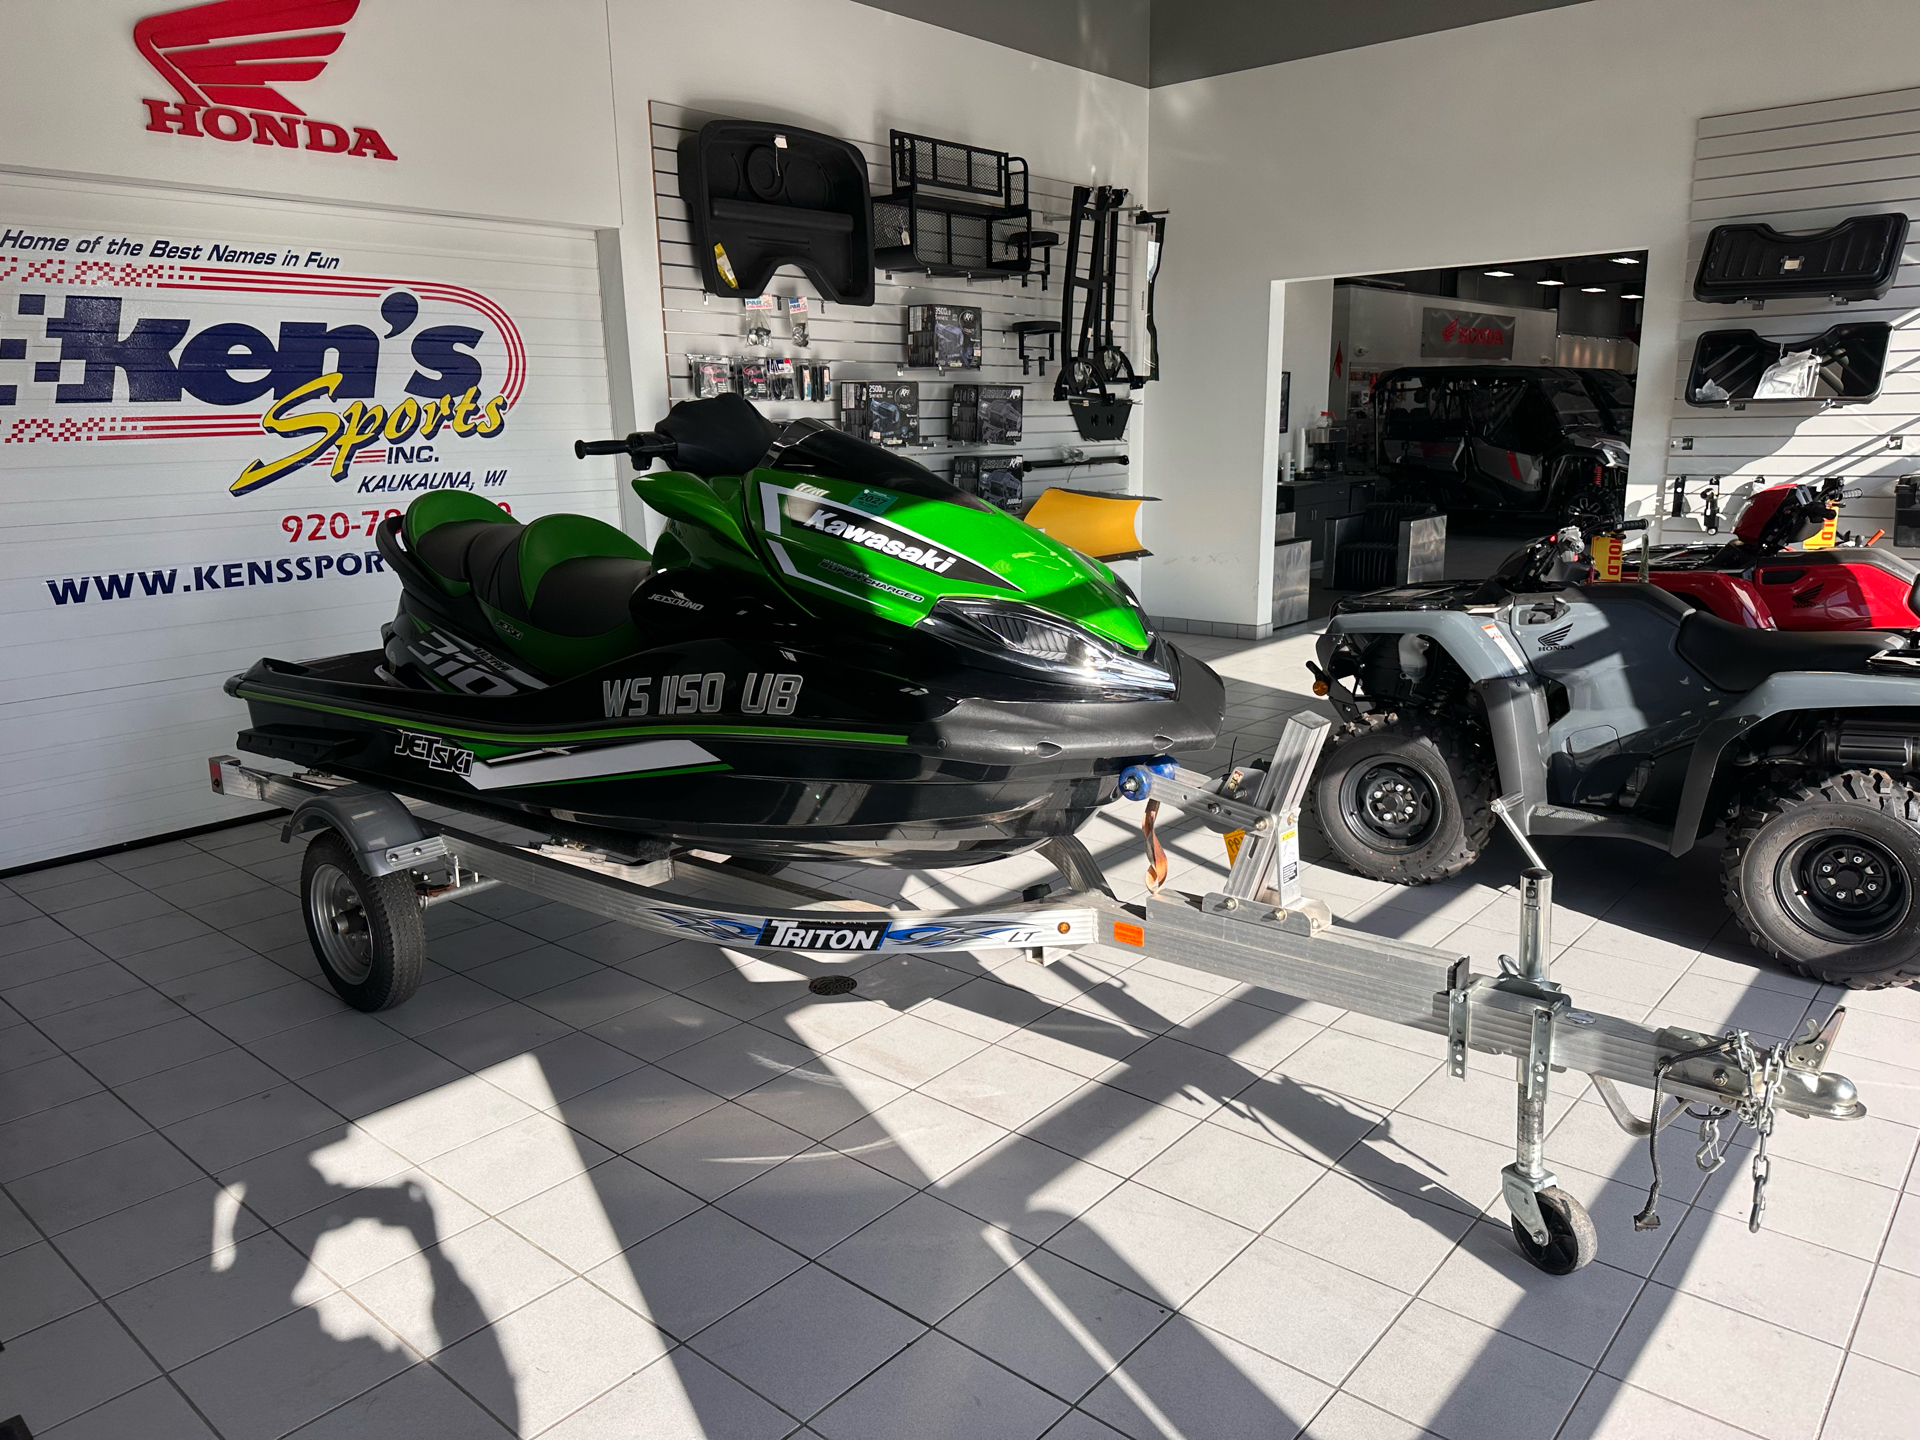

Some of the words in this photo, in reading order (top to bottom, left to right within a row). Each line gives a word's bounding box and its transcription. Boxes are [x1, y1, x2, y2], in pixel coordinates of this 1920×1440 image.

[142, 98, 398, 161] HONDA
[0, 229, 70, 252] Home
[75, 236, 104, 253] of
[106, 238, 144, 256] the
[149, 240, 202, 259] Best
[207, 244, 277, 265] Names
[281, 250, 300, 266] in
[304, 251, 340, 269] Fun
[1457, 326, 1504, 345] HONDA
[229, 372, 507, 497] Sports
[386, 445, 439, 465] INC.
[357, 471, 475, 494] KAUKAUNA,
[484, 470, 507, 486] WI
[858, 493, 888, 505] 2027
[803, 509, 957, 574] Kawasaki
[647, 593, 704, 611] JETSOUND
[407, 631, 518, 696] 310
[473, 647, 514, 671] ULTRA
[603, 677, 652, 718] WS
[658, 672, 726, 716] 1150
[741, 672, 804, 716] UB
[769, 919, 879, 950] TRITON
[1008, 930, 1039, 943] LT
